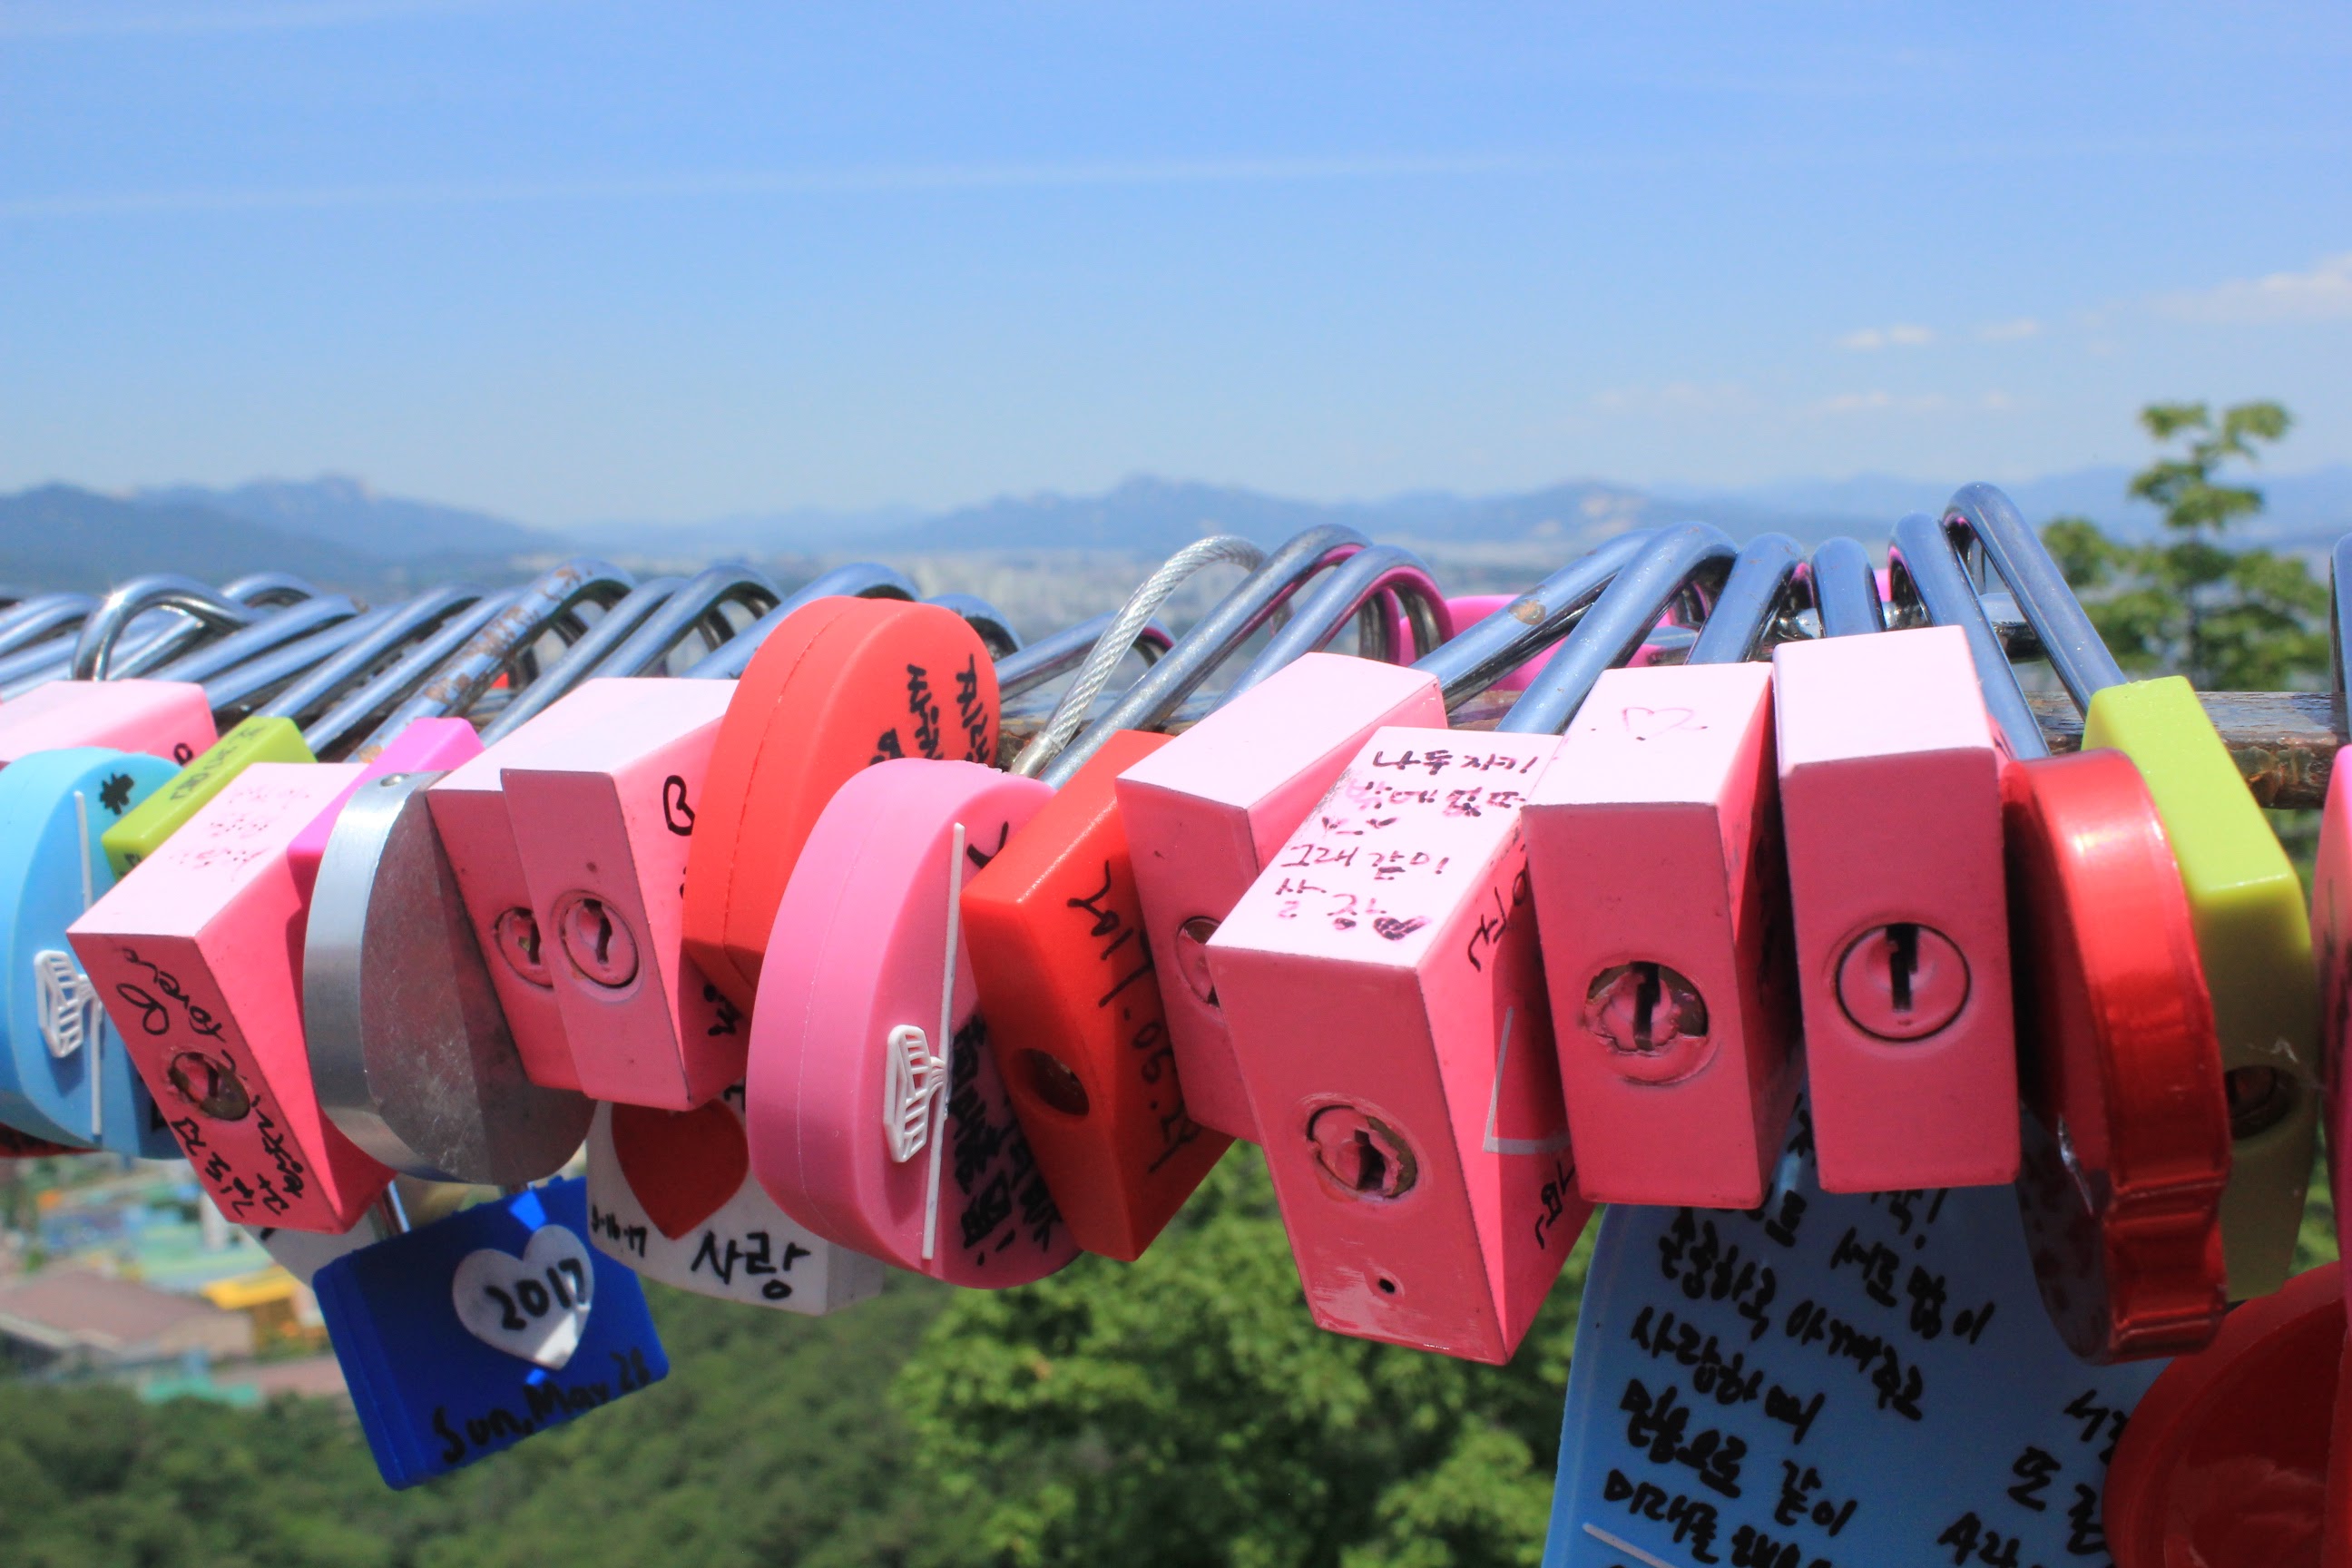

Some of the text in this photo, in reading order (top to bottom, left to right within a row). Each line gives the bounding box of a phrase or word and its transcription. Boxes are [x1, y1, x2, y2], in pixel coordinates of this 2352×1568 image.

[1280, 843, 1359, 867] 그래
[484, 1257, 587, 1331] 2017
[691, 1230, 811, 1300] 사랑
[1630, 1306, 1825, 1445] 사랑하며
[1603, 1468, 1720, 1564] 미래를
[1774, 1459, 1857, 1537] 같이
